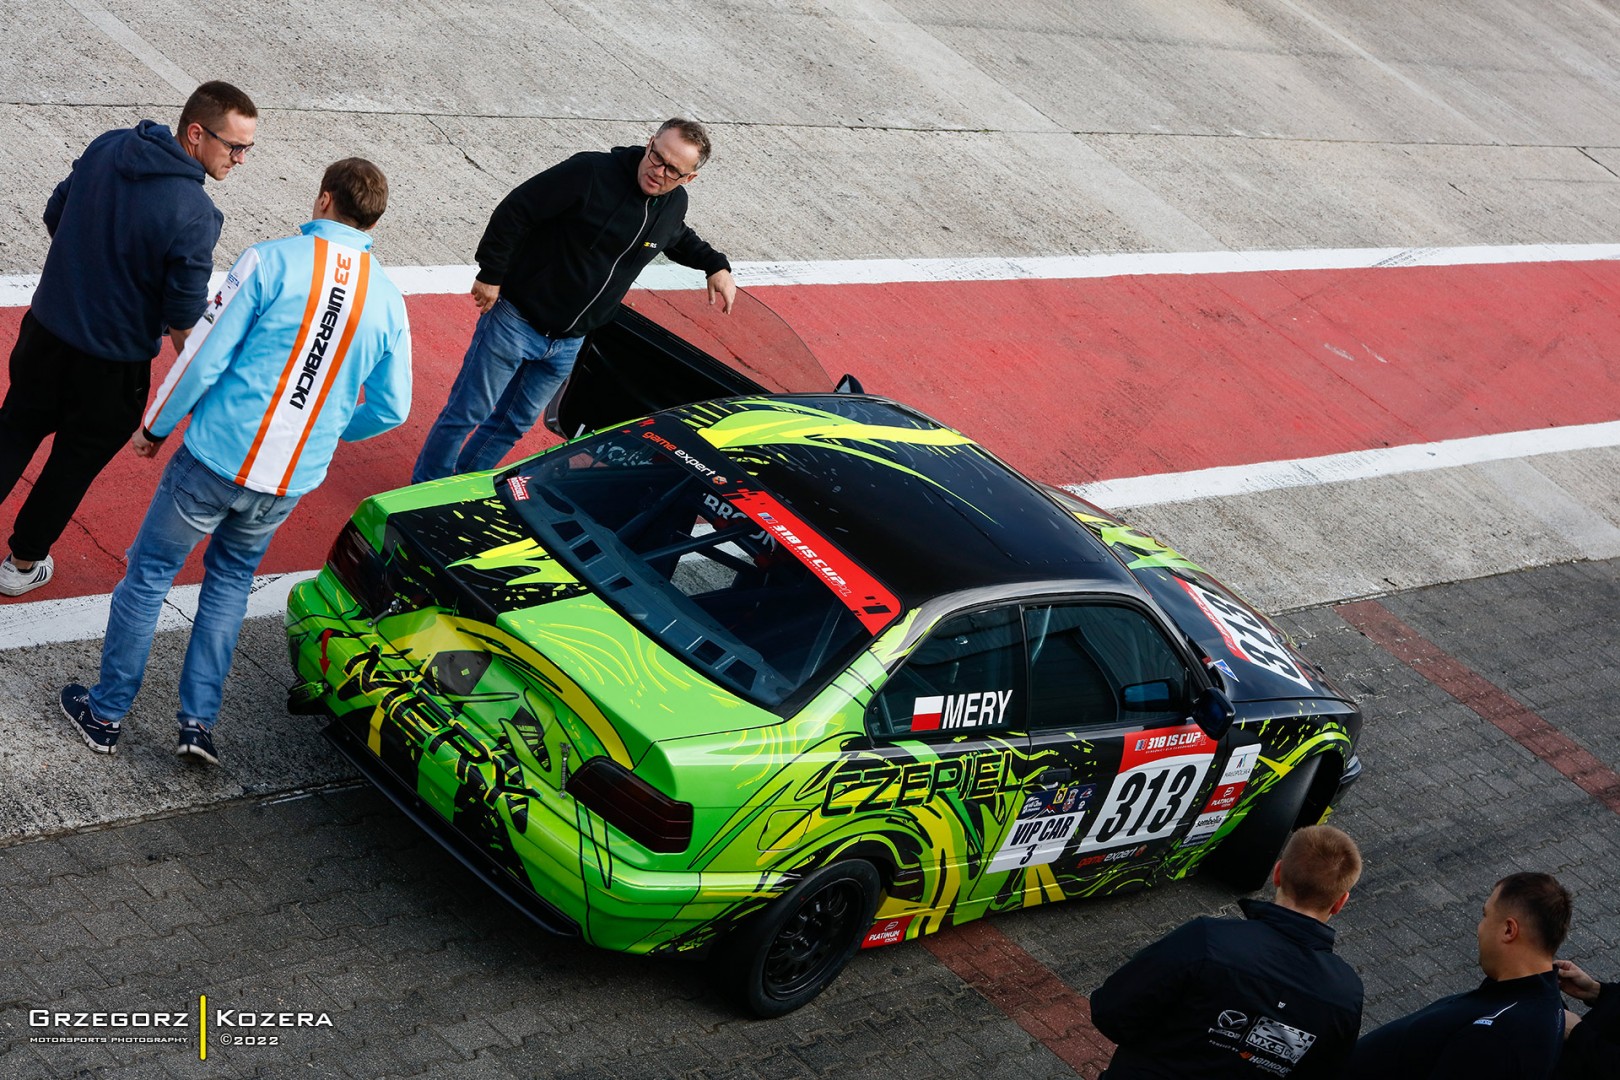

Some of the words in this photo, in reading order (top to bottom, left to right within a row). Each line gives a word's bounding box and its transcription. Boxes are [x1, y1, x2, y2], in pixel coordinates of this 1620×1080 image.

[334, 253, 352, 286] 33
[289, 286, 346, 410] WIERZBICKI
[642, 430, 677, 452] game
[674, 449, 716, 477] expert
[773, 525, 802, 545] 318
[797, 545, 818, 559] IS
[812, 558, 846, 585] CUP
[1202, 592, 1301, 690] 313
[942, 690, 1013, 729] MERY
[1147, 736, 1166, 750] 318
[1166, 734, 1179, 747] IS
[1178, 731, 1201, 745] CUP
[820, 751, 1022, 817] CZEPIEL
[1096, 765, 1197, 843] 313
[1010, 820, 1043, 846] VIP
[1038, 816, 1075, 841] CAR
[1019, 844, 1038, 865] 3
[1104, 846, 1138, 862] expert
[869, 930, 900, 941] PLATINUM
